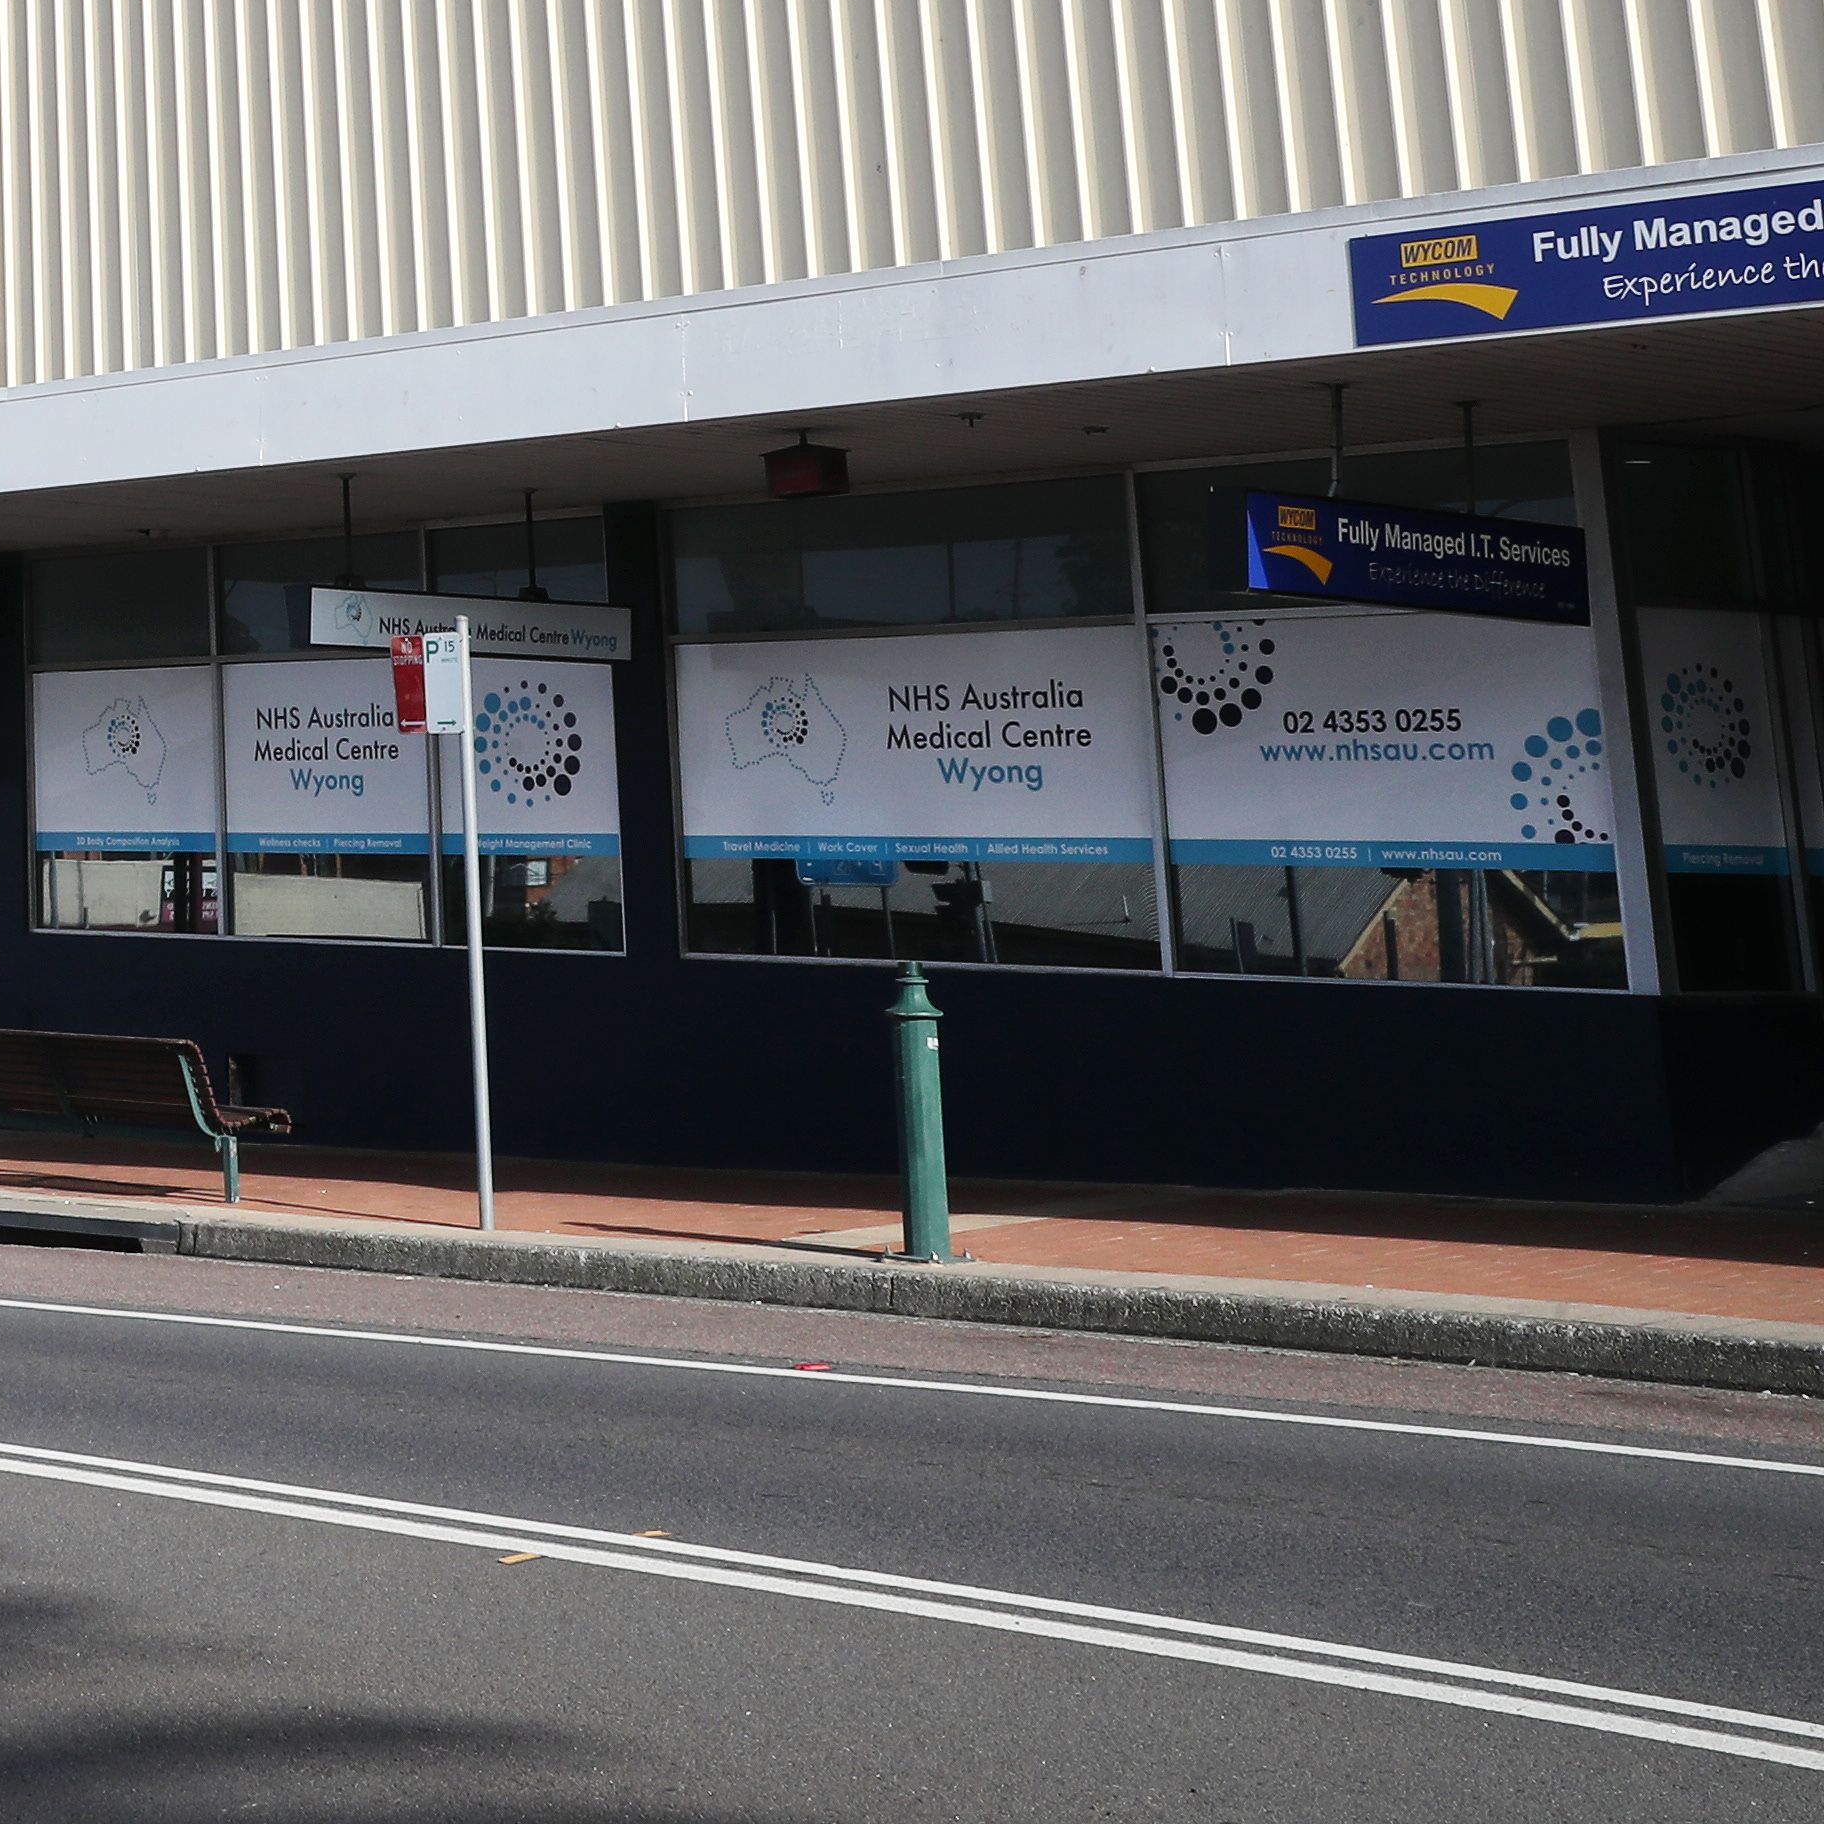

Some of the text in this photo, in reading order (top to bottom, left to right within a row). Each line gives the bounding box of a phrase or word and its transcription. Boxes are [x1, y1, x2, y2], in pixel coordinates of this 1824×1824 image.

[1532, 198, 1824, 264] Fully Managed
[1402, 237, 1474, 265] WYCOM
[1390, 262, 1496, 286] TECHNOLOGY
[1602, 252, 1824, 306] Experience th
[1338, 517, 1571, 568] Fully Managed I.T. Services
[1369, 562, 1546, 599] Experience the Difference
[379, 616, 410, 636] NHS
[476, 624, 527, 643] Medical
[530, 627, 569, 645] Centre
[569, 628, 618, 652] Wyong
[425, 640, 440, 664] P
[444, 640, 455, 653] 15
[887, 678, 1084, 712] NHS Australia
[256, 702, 395, 731] NHS Australia
[1282, 708, 1462, 734] 02 4353 0255
[887, 719, 1093, 750] Medical Centre
[254, 738, 400, 762] Medical Centre
[1259, 738, 1495, 762] www.nhsau.com
[289, 768, 365, 798] Wyong
[936, 756, 1043, 792] Wyong
[105, 837, 151, 849] Composition
[151, 837, 181, 849] Analysis
[258, 837, 403, 850] Wellness checks Piercing Removal
[478, 838, 592, 851] eight Management Clinic
[723, 840, 1108, 856] Travel Medicine Work Cover Sexual Health Allied Health Services
[1270, 845, 1503, 862] 02 4353 0255 www.nhsau.com
